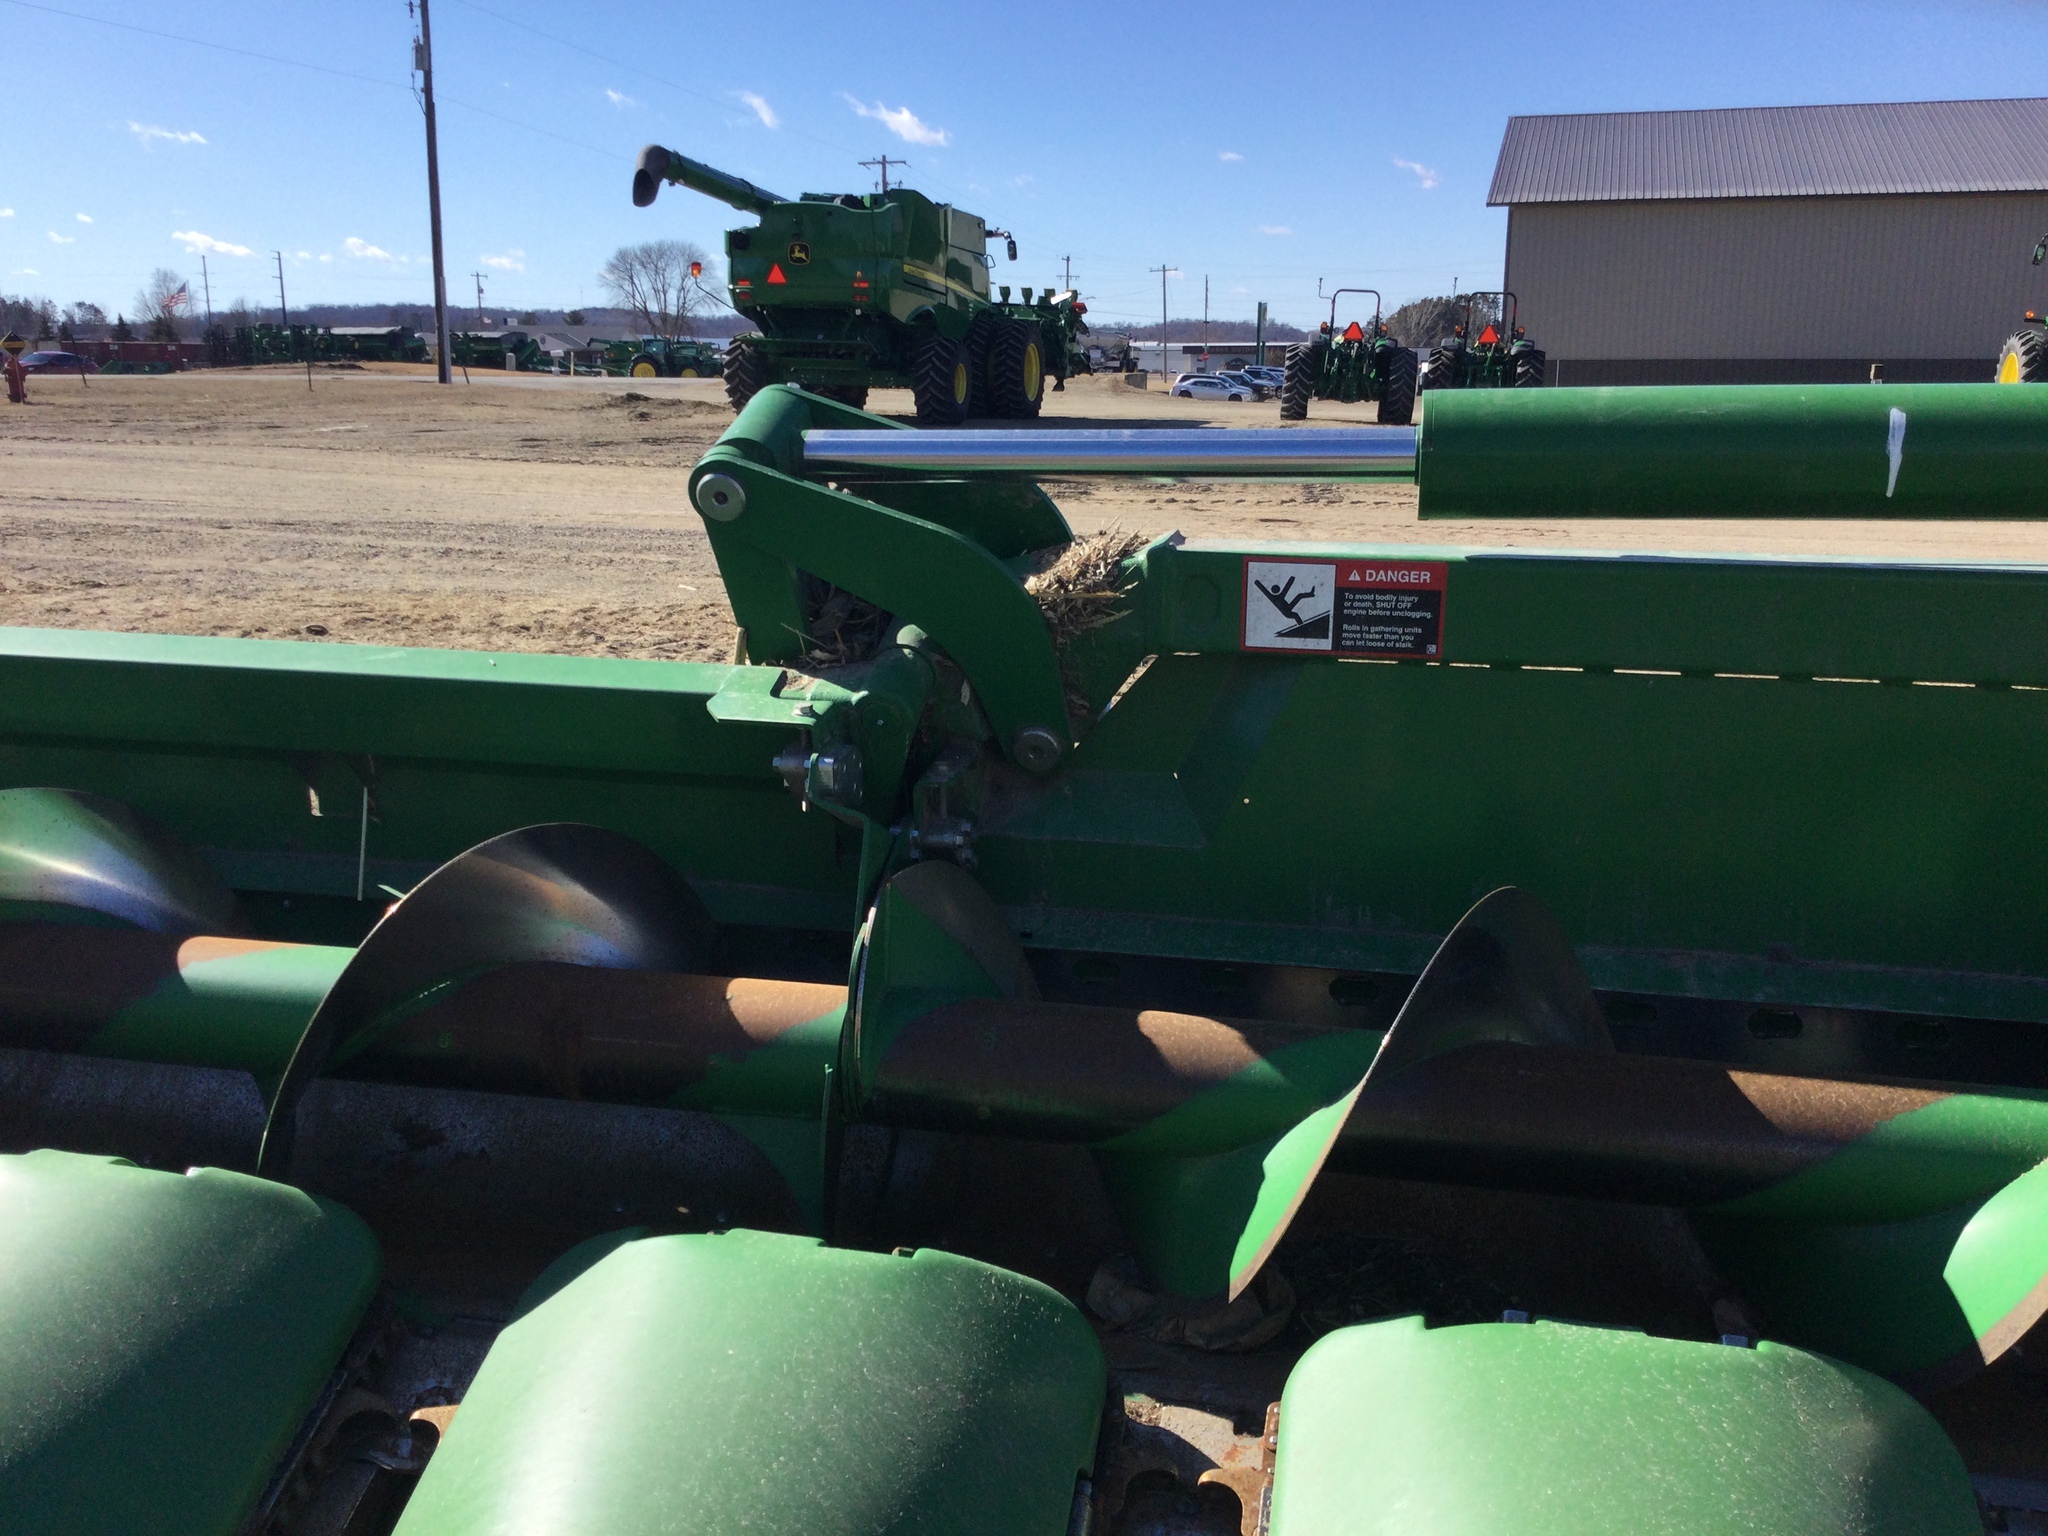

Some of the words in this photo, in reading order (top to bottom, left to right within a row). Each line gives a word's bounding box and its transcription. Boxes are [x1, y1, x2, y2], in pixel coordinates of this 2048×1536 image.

[1366, 569, 1431, 583] DANGER
[1375, 594, 1397, 602] bodily
[1392, 610, 1433, 619] unclogging.
[1370, 625, 1403, 634] gathering
